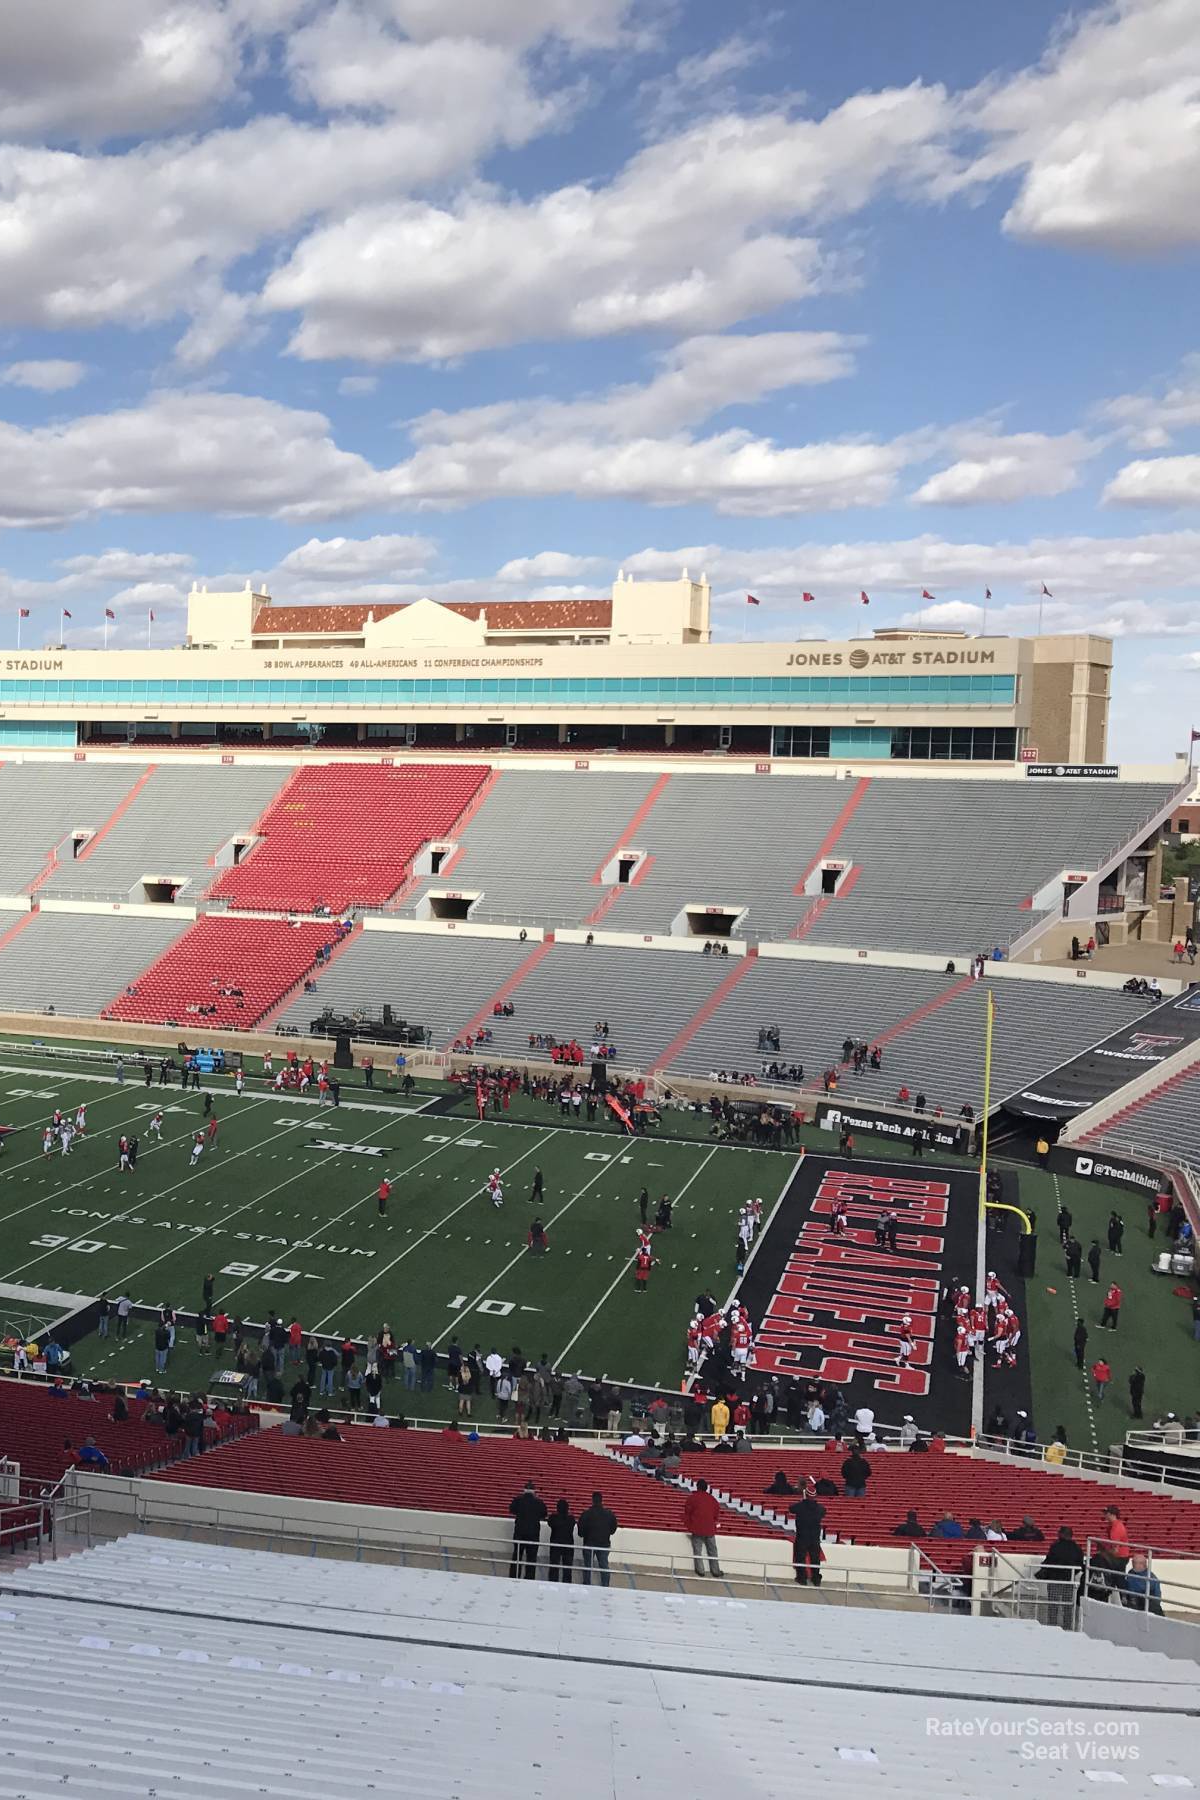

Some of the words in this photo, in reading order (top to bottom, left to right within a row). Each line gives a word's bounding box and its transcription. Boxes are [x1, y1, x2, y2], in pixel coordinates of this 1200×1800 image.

[6, 660, 63, 670] STADIUM
[274, 660, 294, 669] BOWL
[295, 660, 344, 668] APPEARANCES
[360, 660, 418, 668] ALL-AMERICANS
[434, 659, 480, 667] CONFERENCE
[481, 658, 543, 666] CHAMPIONSHIPS
[786, 653, 842, 666] JONES
[872, 652, 906, 665] AT&T
[912, 650, 995, 664] STADIUM
[1021, 1091, 1094, 1108] GEICO
[843, 1115, 874, 1129] Texas
[875, 1121, 902, 1135] Tech
[51, 1207, 147, 1224] JONES
[152, 1221, 228, 1236] AT&T
[233, 1232, 377, 1257] STADIUM
[29, 1234, 108, 1253] 30
[219, 1261, 302, 1283] 20
[446, 1295, 517, 1316] 10
